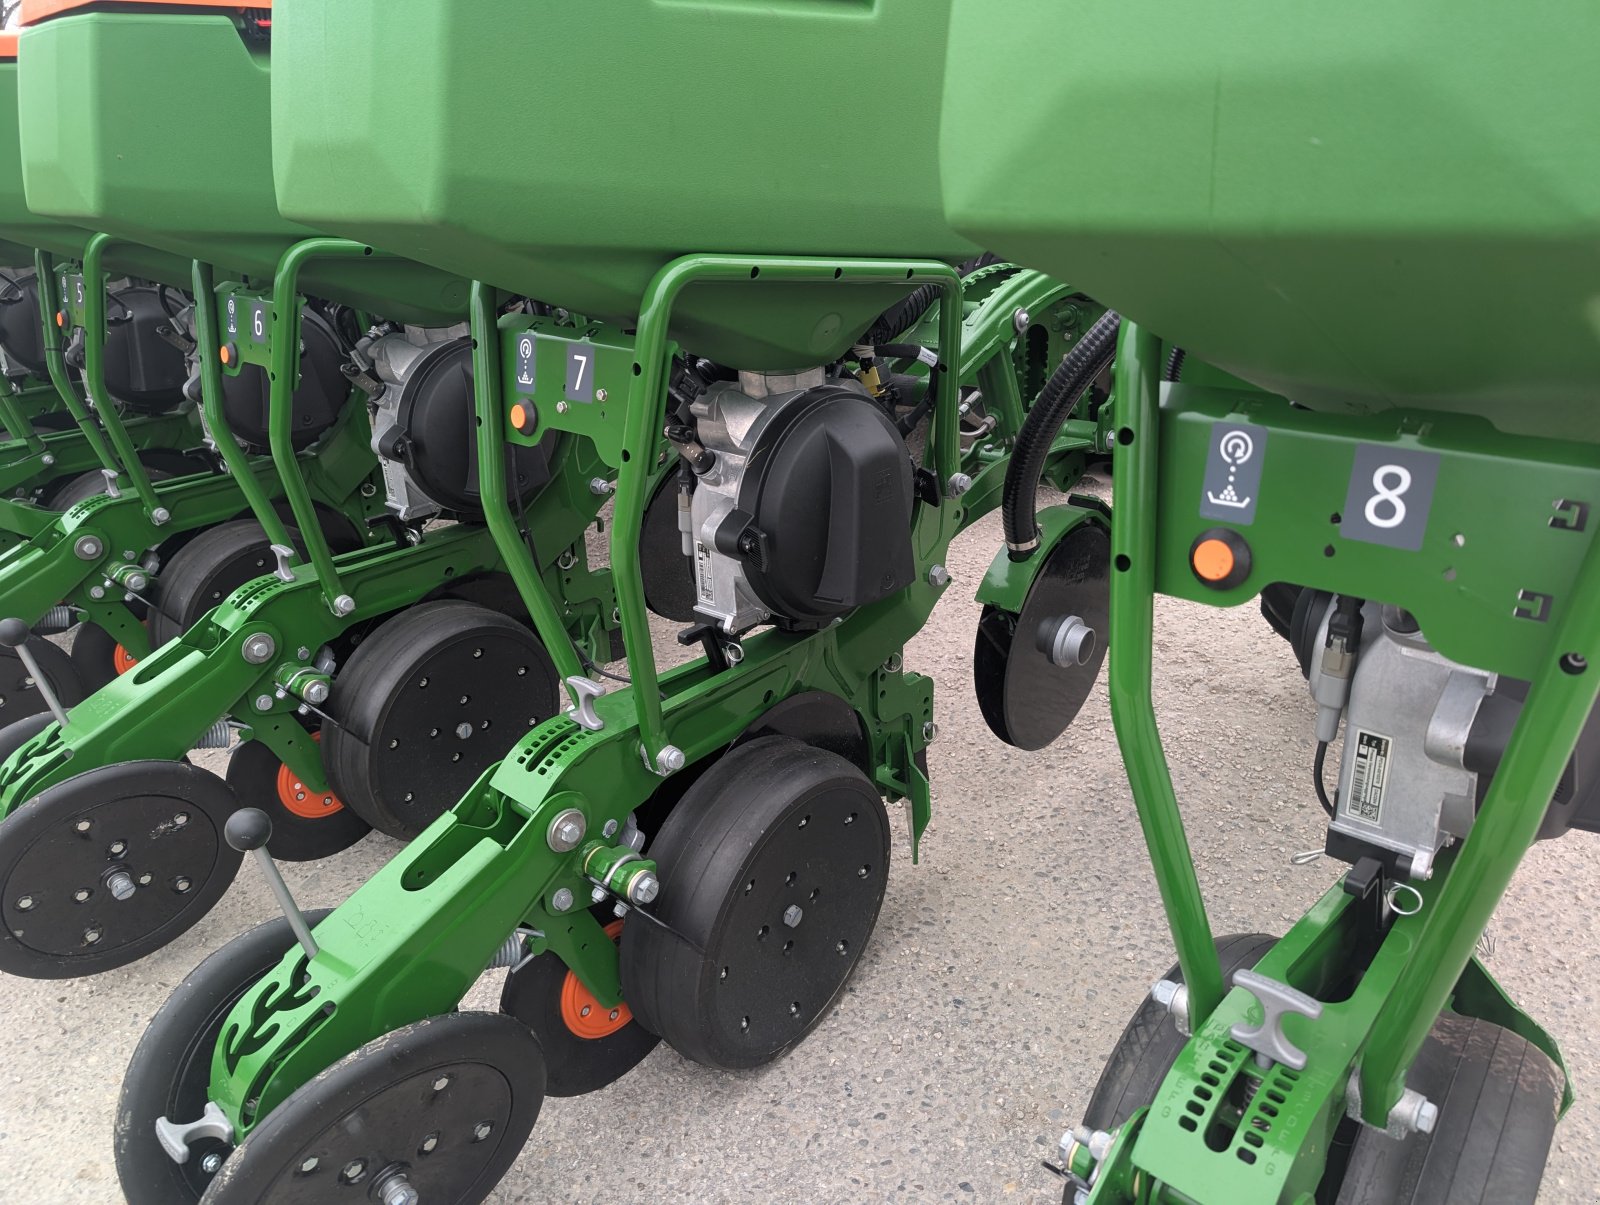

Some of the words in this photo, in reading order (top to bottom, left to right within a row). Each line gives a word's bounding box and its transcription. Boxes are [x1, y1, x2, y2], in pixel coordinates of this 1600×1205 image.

[77, 282, 83, 303] 5
[254, 309, 263, 336] 6
[574, 354, 587, 391] 7
[1365, 464, 1412, 528] 8
[1161, 1105, 1172, 1118] G
[1264, 1161, 1276, 1176] G
